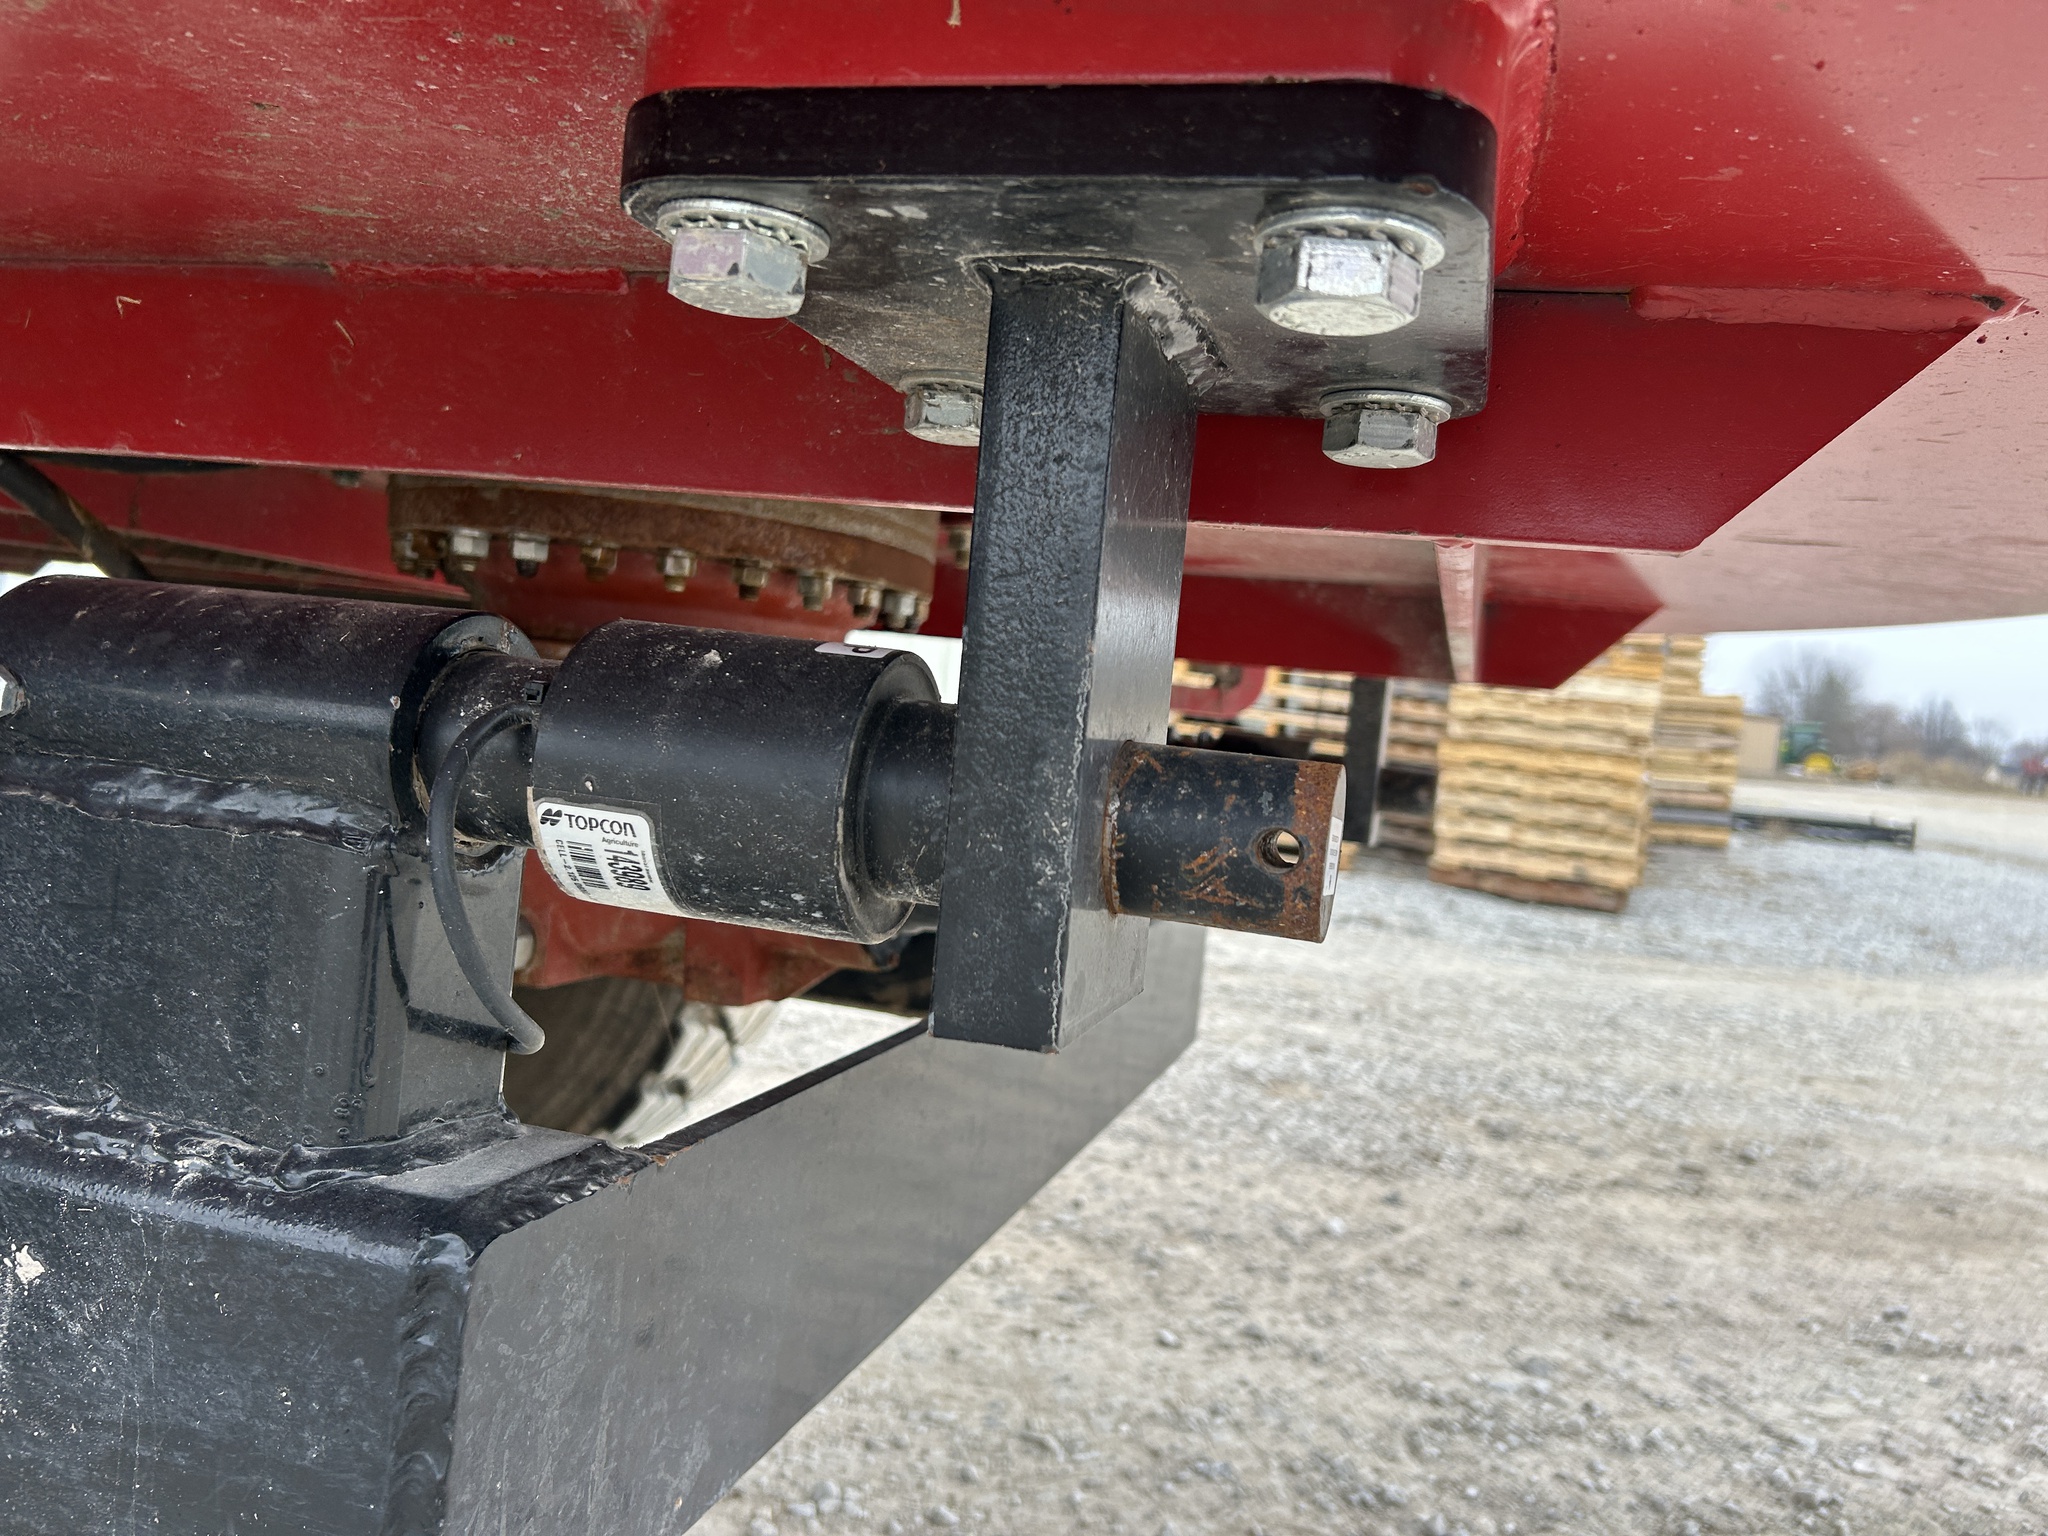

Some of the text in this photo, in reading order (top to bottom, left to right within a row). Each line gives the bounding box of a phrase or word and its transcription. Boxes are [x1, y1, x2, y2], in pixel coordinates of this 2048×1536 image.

[564, 813, 637, 838] TOPCON
[602, 837, 639, 848] Agriculture
[604, 849, 651, 891] 143989
